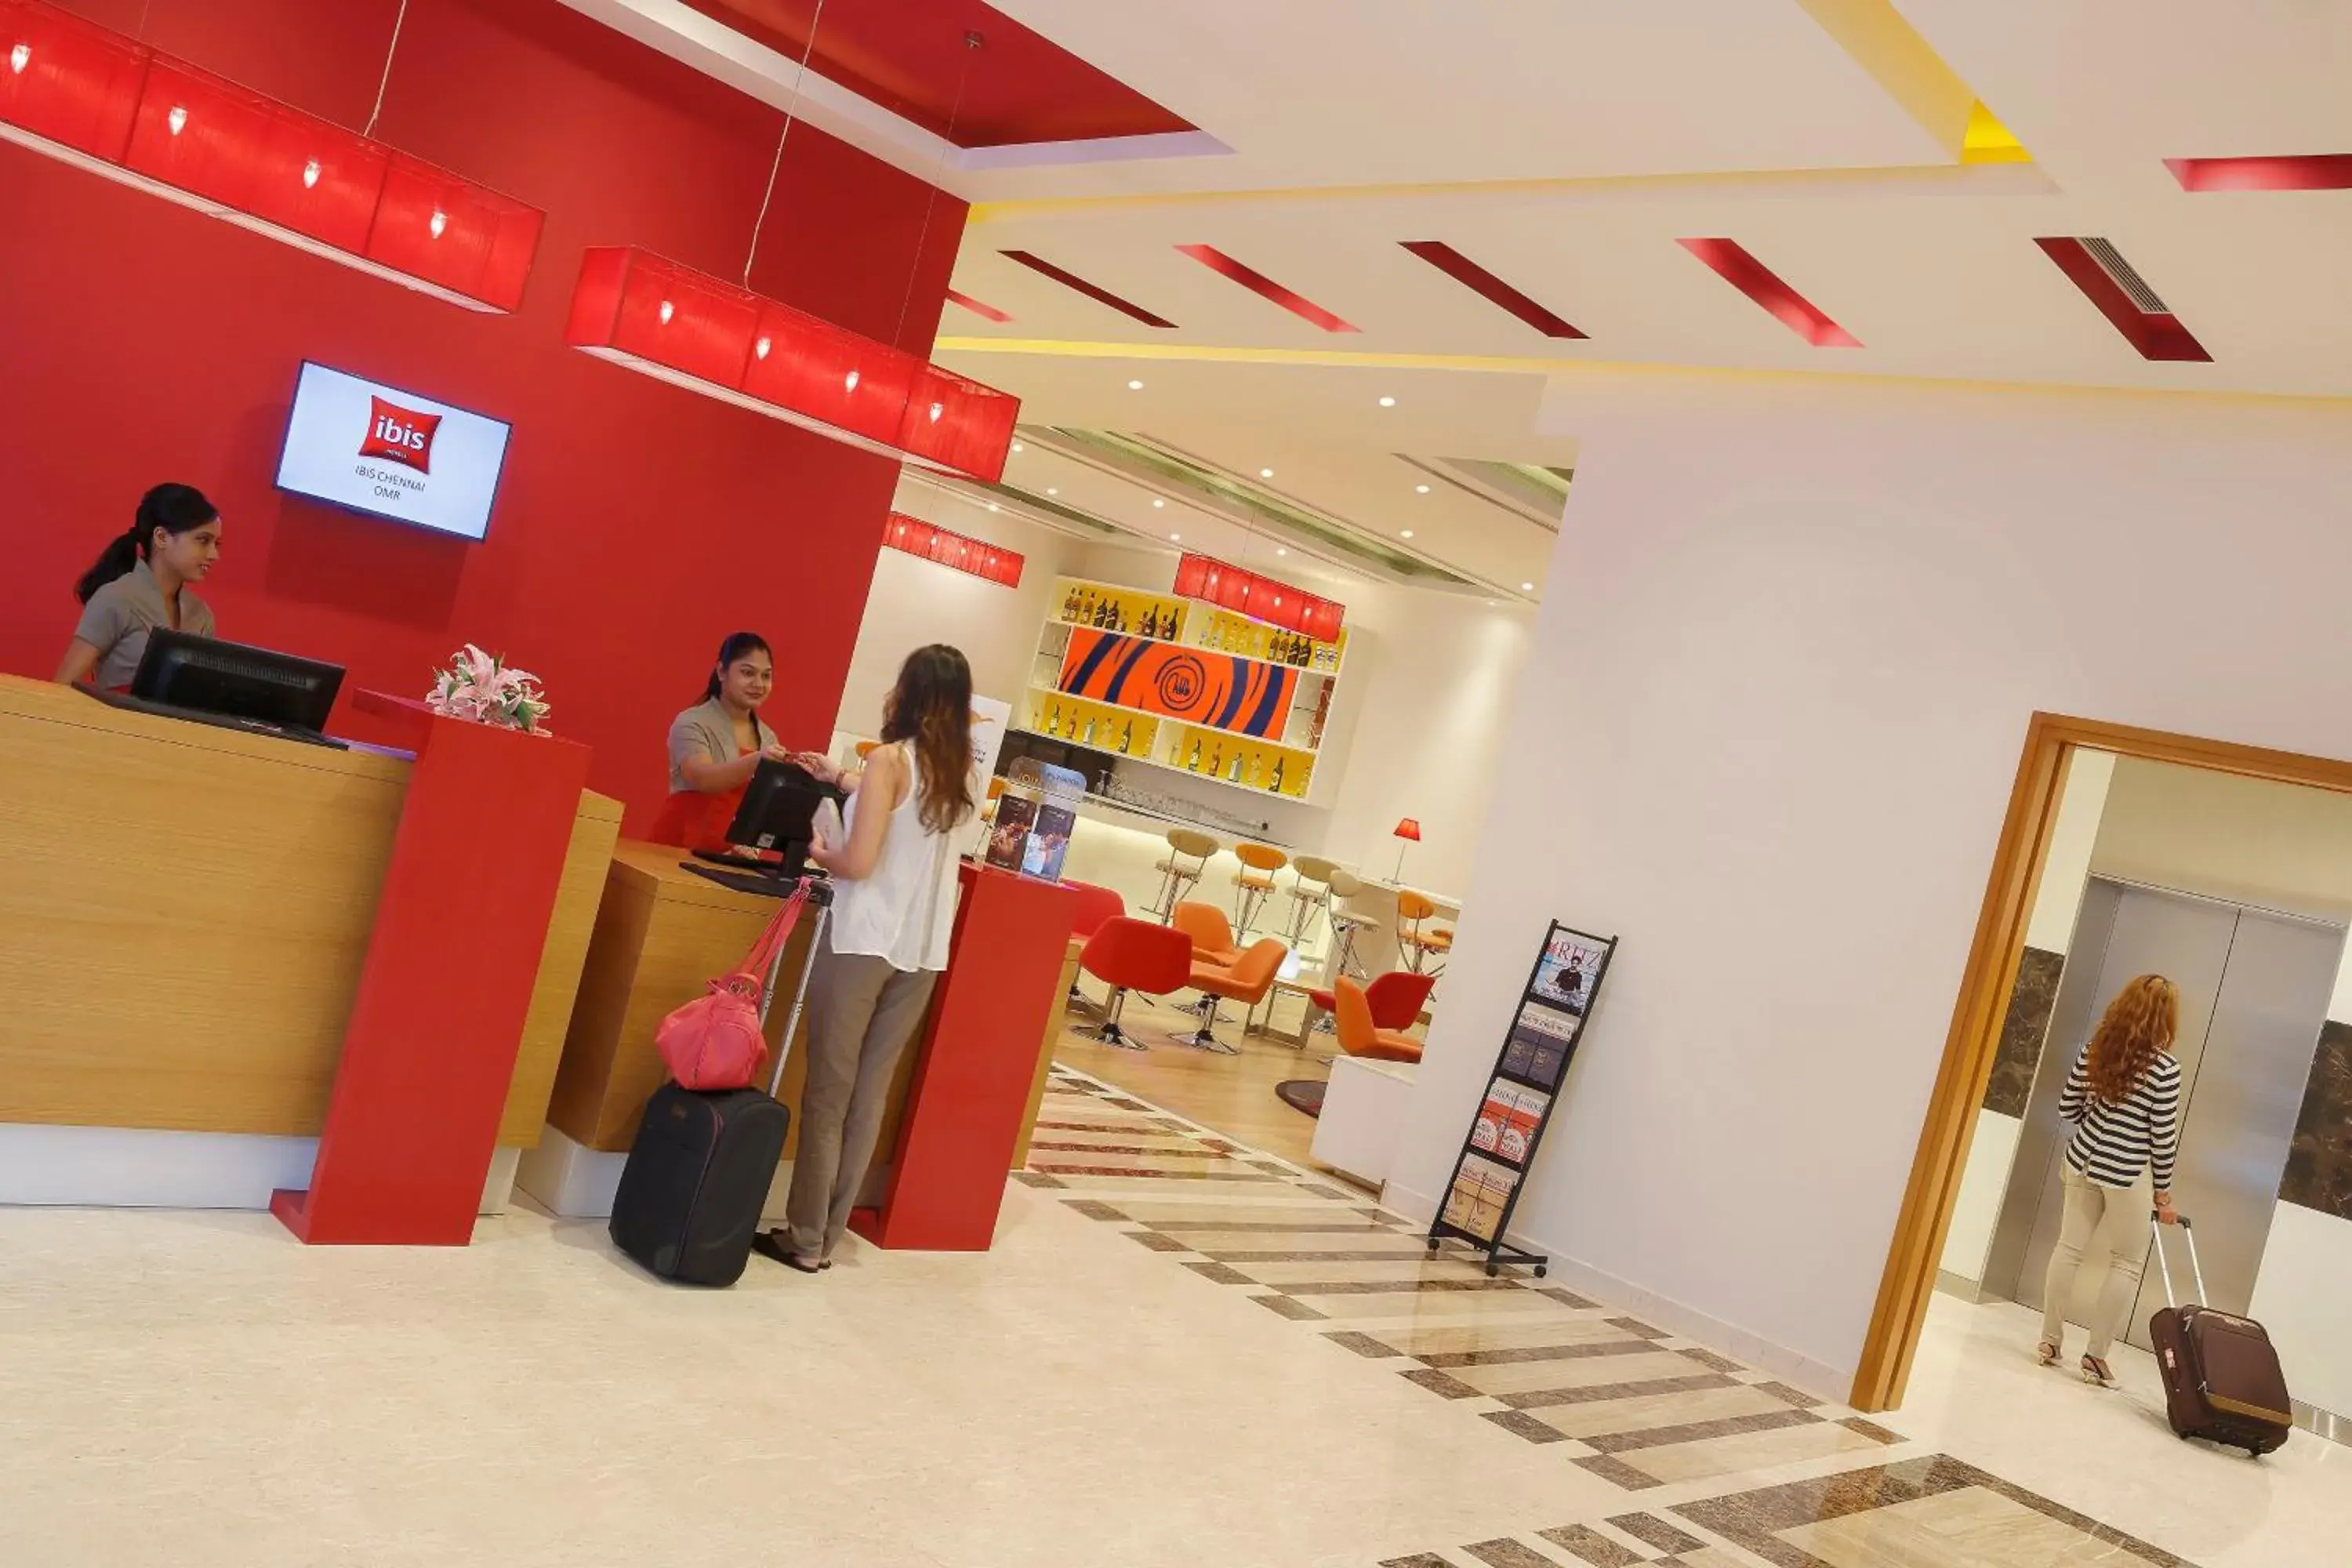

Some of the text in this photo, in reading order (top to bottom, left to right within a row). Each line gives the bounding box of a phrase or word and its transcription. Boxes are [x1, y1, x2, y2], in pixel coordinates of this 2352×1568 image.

[374, 415, 425, 450] ibis
[355, 465, 426, 492] IBIS CHENNAI
[374, 485, 401, 499] OMR
